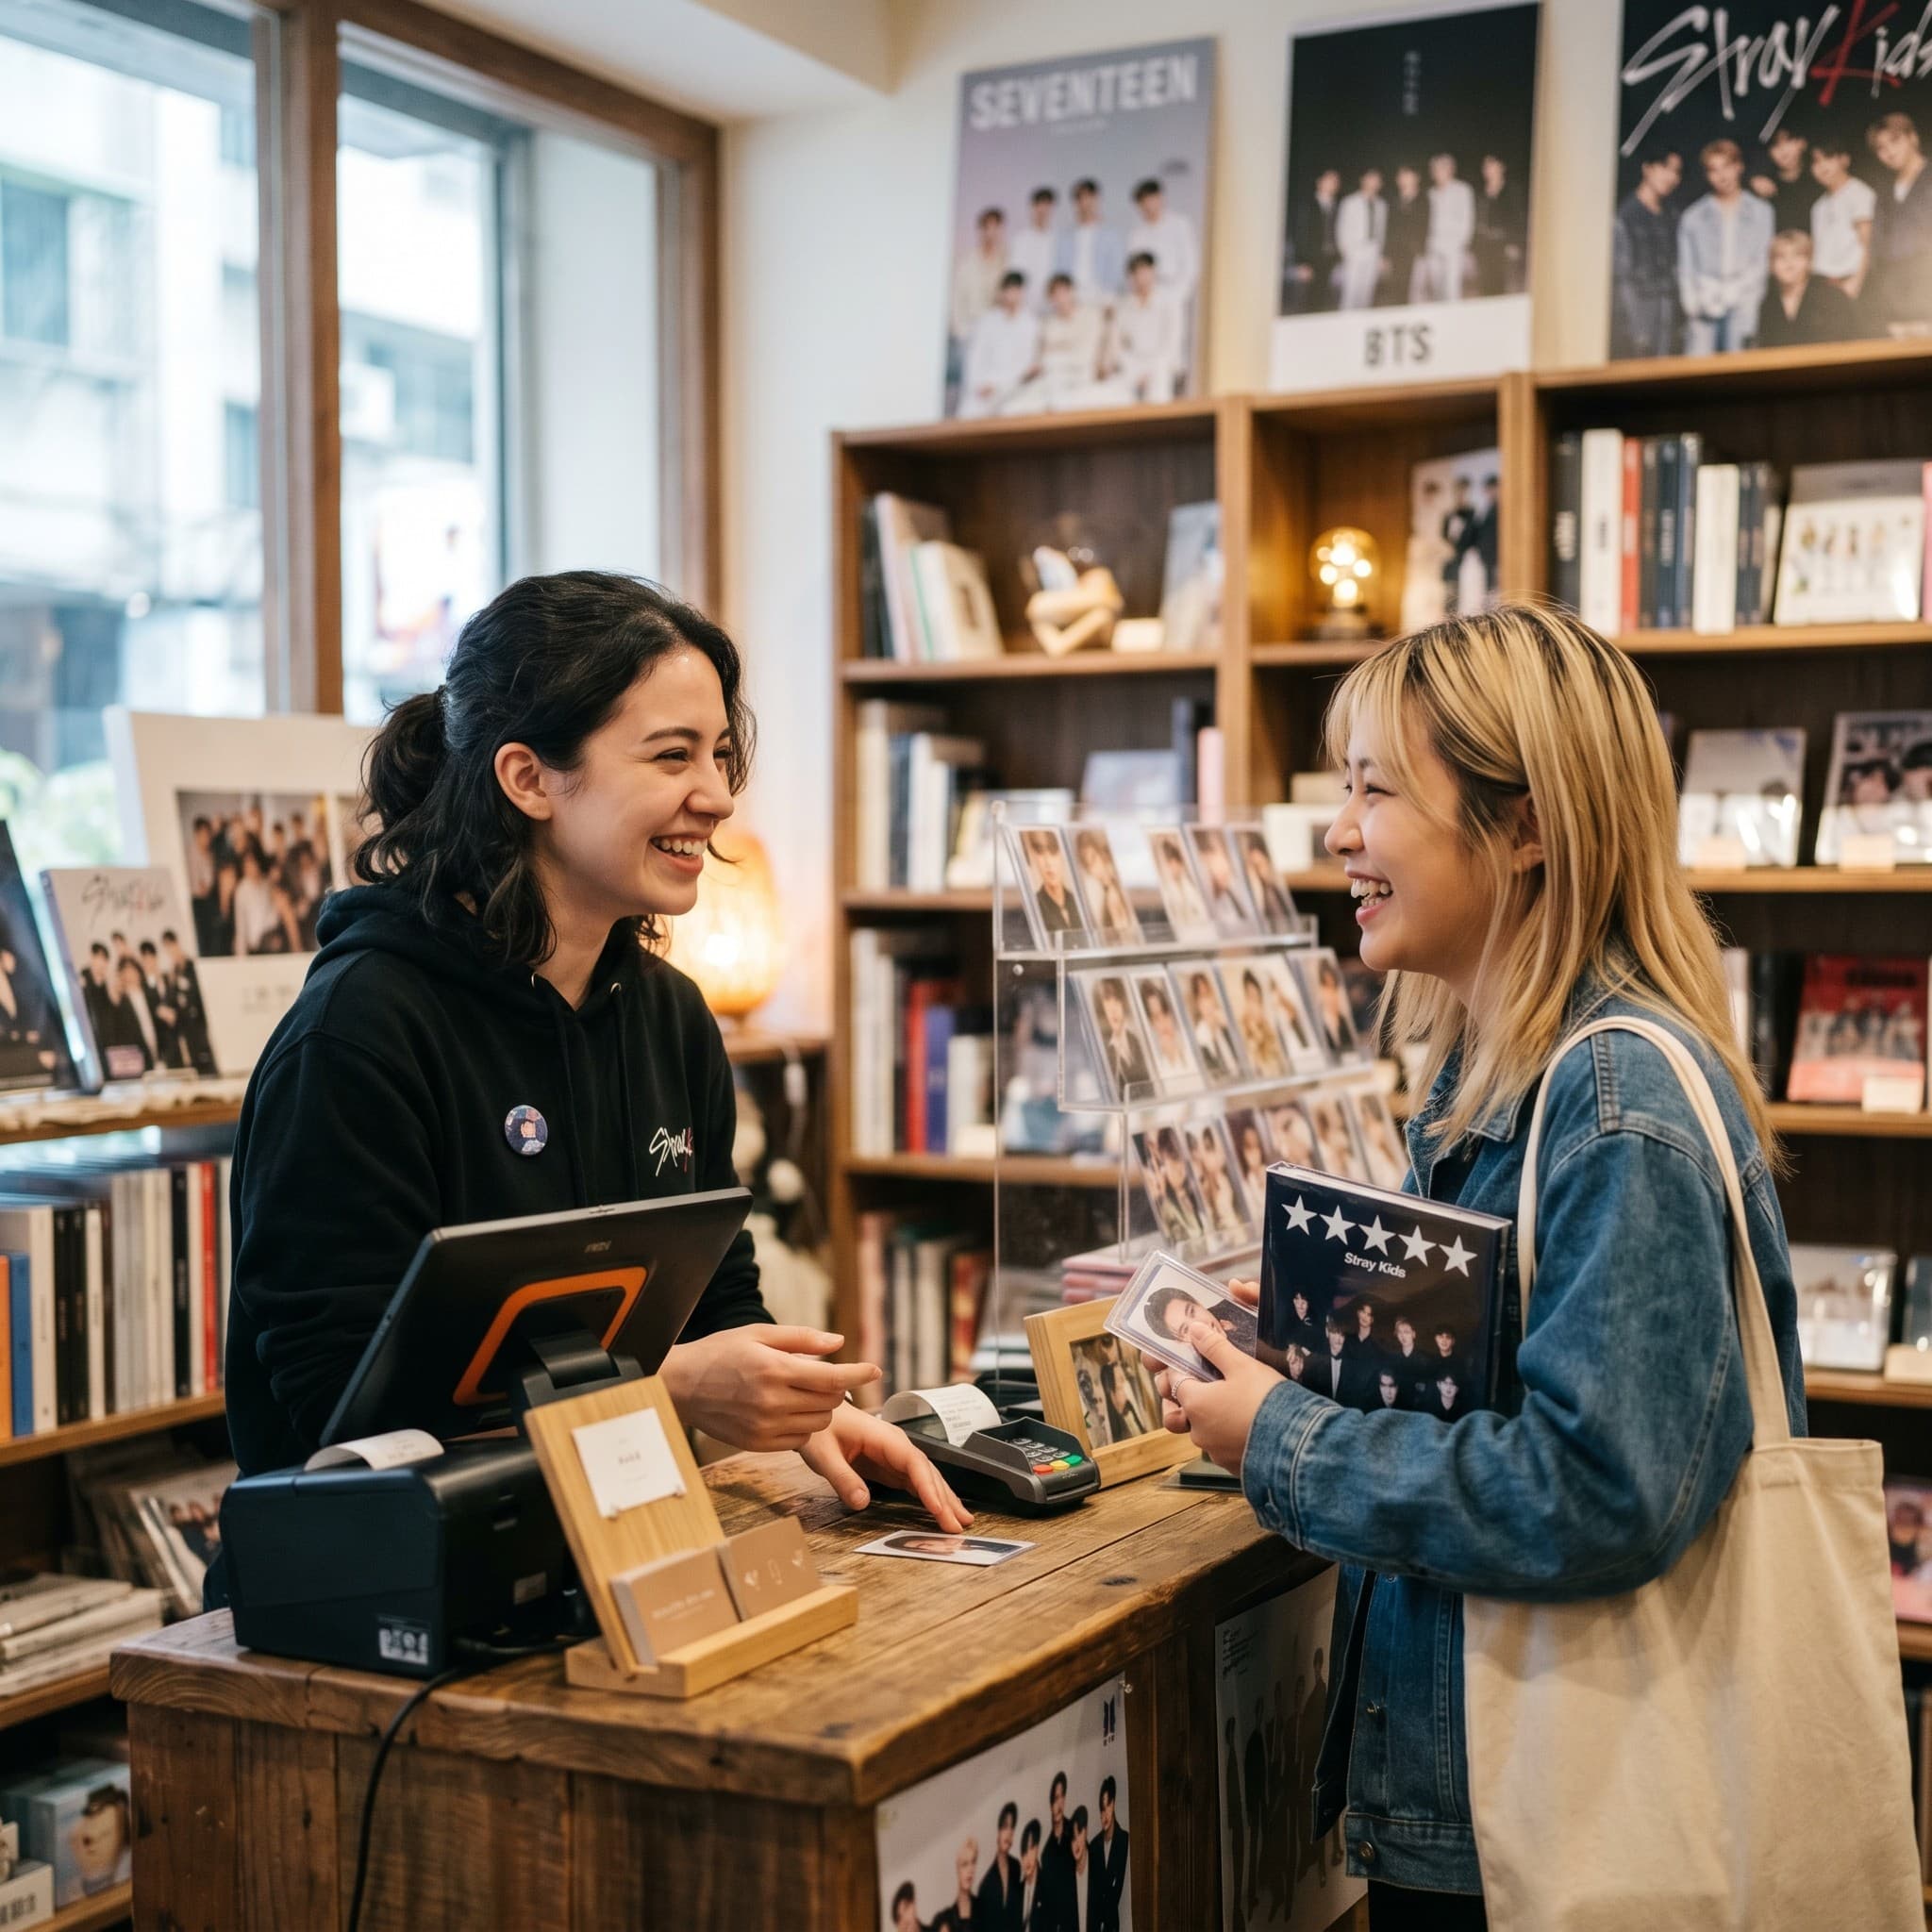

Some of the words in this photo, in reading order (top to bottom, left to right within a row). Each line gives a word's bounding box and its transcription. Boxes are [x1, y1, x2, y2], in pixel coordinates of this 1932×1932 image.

[970, 54, 1198, 131] SEVENTEEN
[1621, 5, 1841, 158] Stray
[1364, 323, 1433, 367] BTS
[1343, 1252, 1377, 1273] Stray
[1377, 1260, 1407, 1278] Kids
